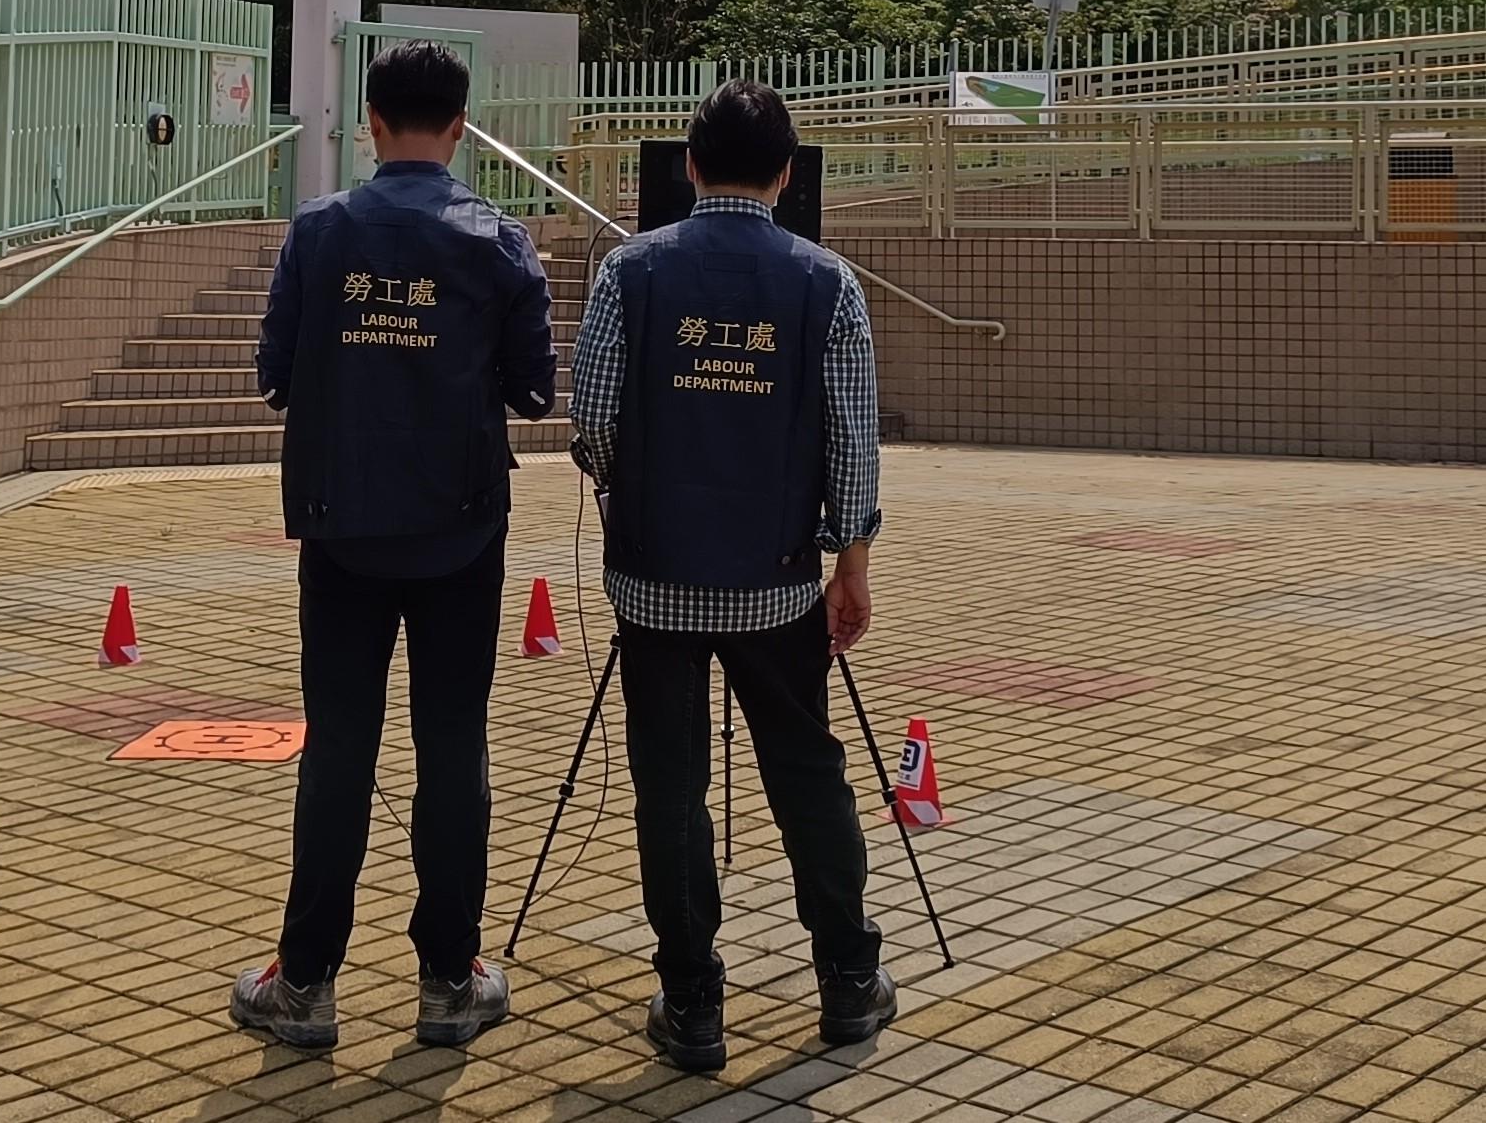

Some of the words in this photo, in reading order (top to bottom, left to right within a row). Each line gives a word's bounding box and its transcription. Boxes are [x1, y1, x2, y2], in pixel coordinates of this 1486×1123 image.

[343, 272, 437, 308] 勞工處
[360, 313, 419, 330] LABOUR
[341, 330, 438, 348] DEPARTMENT
[676, 316, 778, 353] 勞工處
[693, 358, 756, 376] LABOUR
[672, 375, 775, 395] DEPARTMENT
